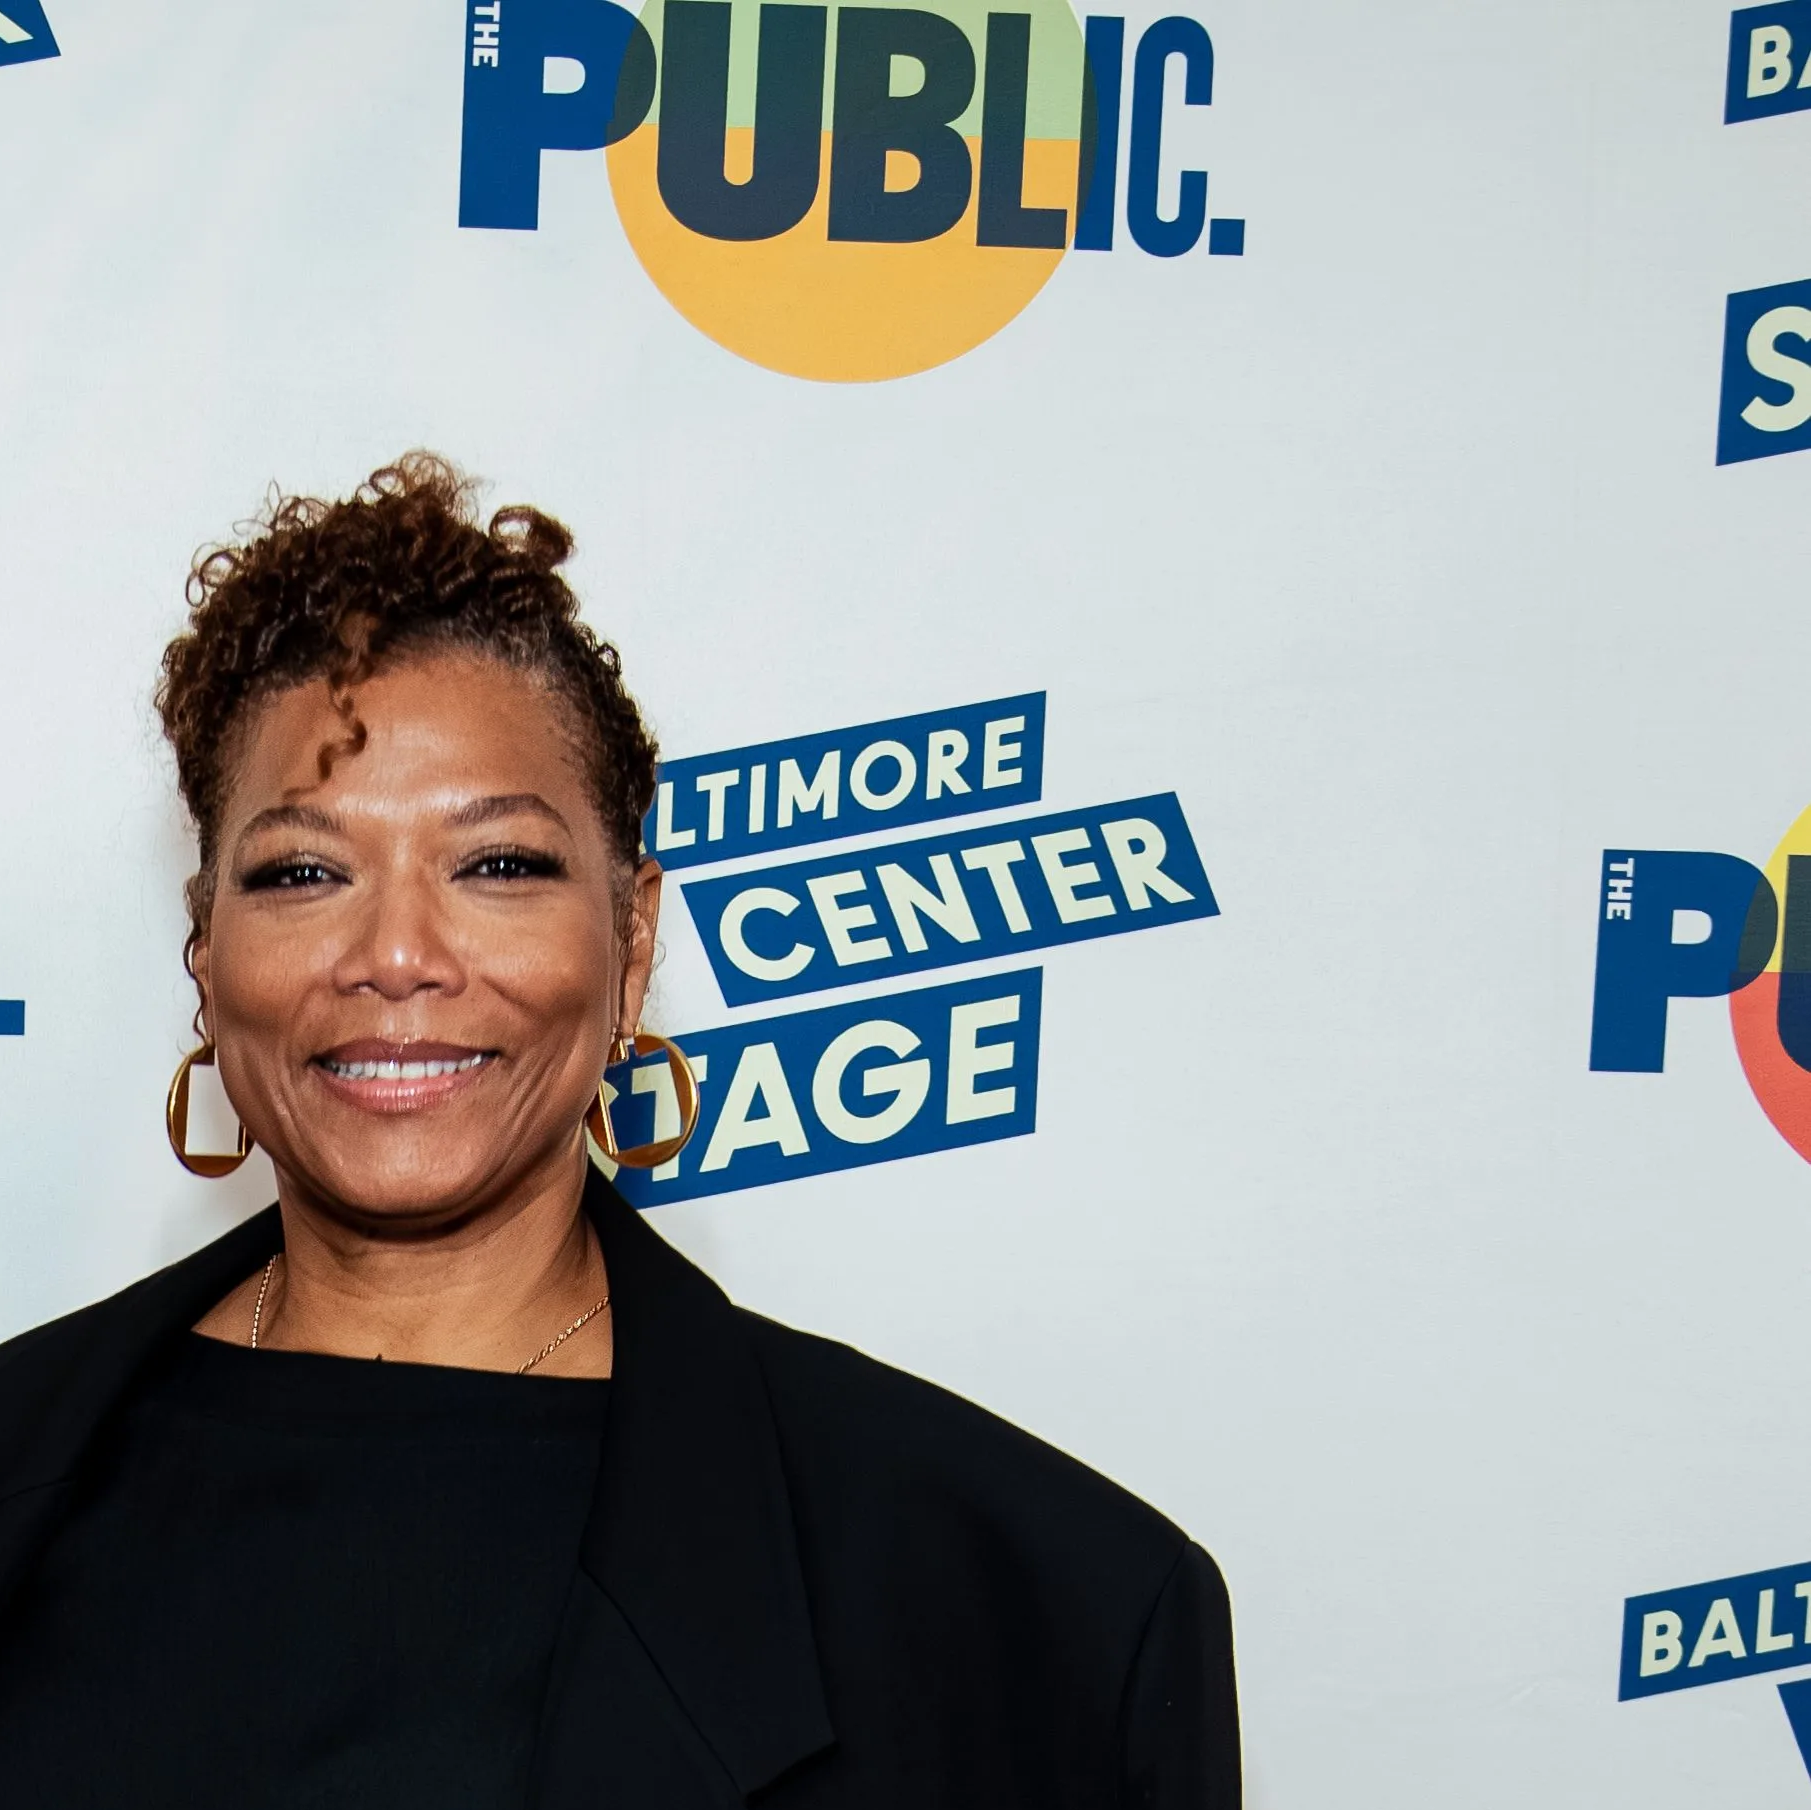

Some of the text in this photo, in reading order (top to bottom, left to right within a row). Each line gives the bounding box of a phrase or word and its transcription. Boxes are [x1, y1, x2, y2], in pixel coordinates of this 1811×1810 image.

[472, 0, 501, 68] THE
[458, 0, 1245, 257] PUBLIC.
[638, 716, 1026, 855] LTIMORE
[719, 817, 1196, 981] CENTER
[1606, 857, 1636, 920] THE
